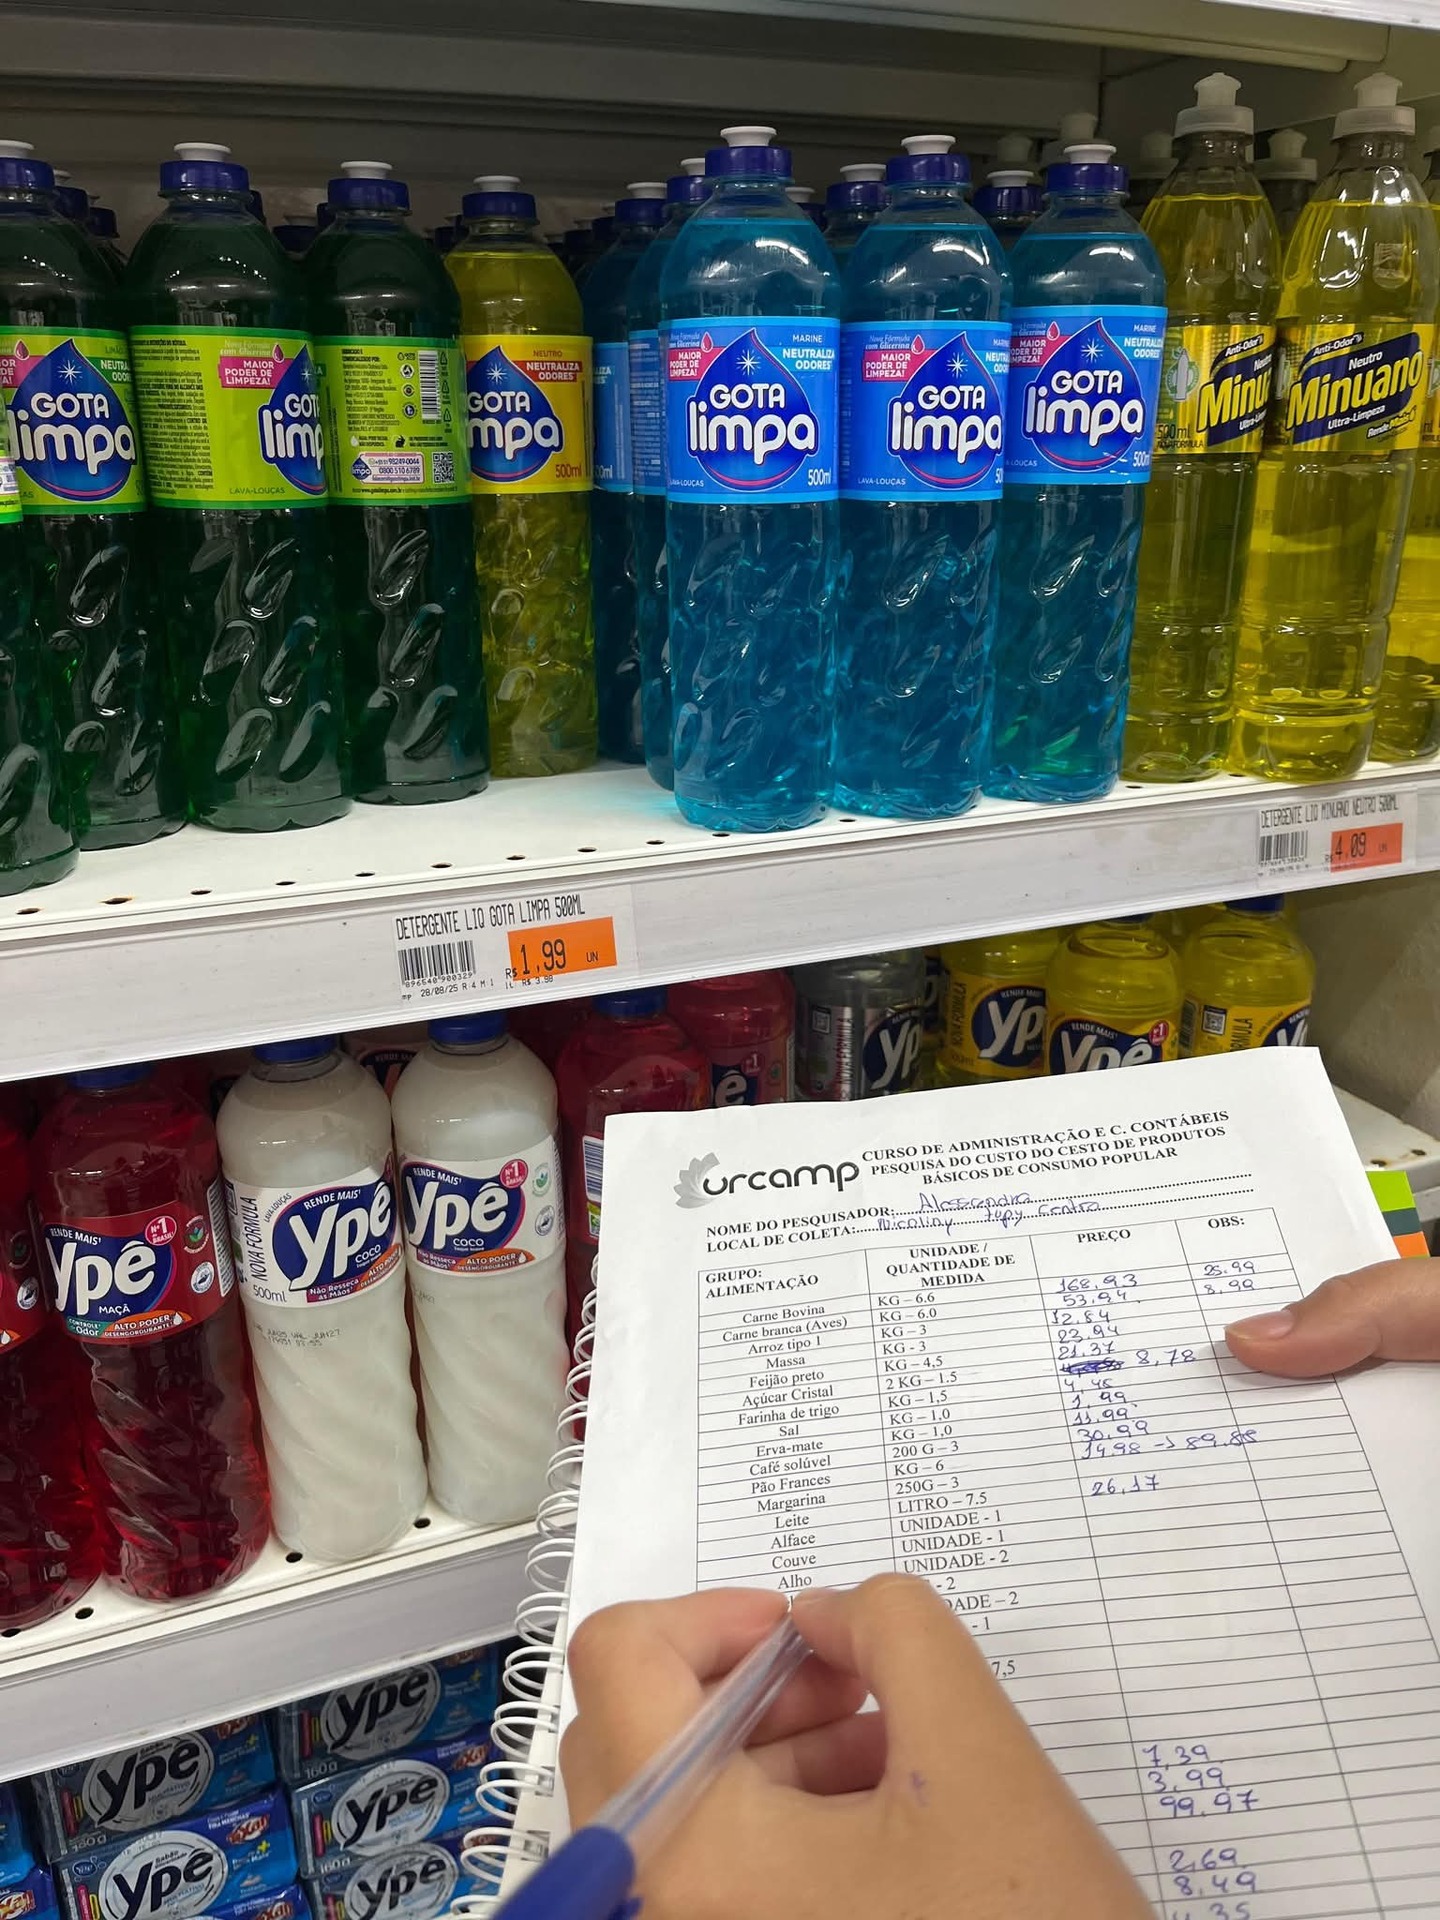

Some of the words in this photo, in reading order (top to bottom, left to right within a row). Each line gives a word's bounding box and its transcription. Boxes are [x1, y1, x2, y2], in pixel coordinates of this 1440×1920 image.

[1134, 325, 1156, 333] MARINE
[793, 335, 822, 343] MARINE
[783, 348, 835, 358] NEUTRALIZA
[1349, 351, 1383, 371] Neutro
[225, 368, 257, 376] PODER
[260, 369, 272, 377] DE
[244, 360, 274, 369] MAIOR
[526, 362, 580, 371] NEUTRALIZA
[866, 370, 904, 378] LIMPEZA!
[226, 377, 270, 385] LIMPEZA!
[1051, 370, 1122, 394] GOTA
[1286, 350, 1423, 431] Minuano
[31, 392, 109, 418] GOTA
[467, 392, 530, 413] GOTA
[710, 384, 785, 409] GOTA
[918, 386, 985, 410] GOTA
[1025, 386, 1143, 447] limpa
[1328, 405, 1385, 430] Ultra-Limpeza
[689, 401, 815, 465] limpa
[892, 401, 1001, 464] limpa
[1367, 424, 1389, 438] Rende
[7, 409, 136, 475] limpa
[556, 464, 582, 478] 500ml
[808, 468, 831, 485] 500ml
[858, 477, 905, 487] LAVA-LOUÇAS
[1261, 806, 1302, 828] DETERGENTE
[1322, 801, 1349, 819] MINUANO
[1352, 796, 1376, 815] NEUTRO
[396, 910, 460, 940] DETERGENTE
[465, 908, 484, 931] LIQ
[490, 905, 514, 927] GOTA
[520, 899, 549, 923] LIMPA
[555, 894, 585, 918] 500ML
[505, 968, 517, 979] R$
[521, 939, 566, 974] 1,99
[586, 952, 598, 962] UN
[980, 998, 1047, 1058] Yp
[871, 1020, 920, 1090] Yp
[862, 1146, 917, 1162] CURSO
[922, 1144, 944, 1155] DE
[949, 1128, 1090, 1154] ADMINISTRAÇÃO
[1095, 1127, 1106, 1138] E
[1110, 1125, 1126, 1135] C.
[1131, 1110, 1229, 1133] CONTÁBEIS
[871, 1159, 945, 1175] PESQUISA
[950, 1156, 971, 1167] DO
[975, 1150, 1027, 1164] CUSTO
[1032, 1148, 1054, 1159] DO
[1058, 1141, 1109, 1157] CESTO
[1113, 1138, 1136, 1150] DE
[1140, 1126, 1226, 1146] PRODUTOS
[923, 1168, 989, 1185] BÁSICOS
[993, 1166, 1014, 1177] DE
[1018, 1156, 1098, 1174] CONSUMO
[1102, 1147, 1178, 1166] POPULAR
[703, 1161, 860, 1196] urcamp
[303, 1194, 335, 1210] RENDE
[407, 1176, 508, 1249] Ypê
[1208, 1215, 1245, 1229] OBS:
[707, 1222, 752, 1238] NOME
[756, 1219, 778, 1232] DO
[782, 1207, 895, 1229] PESQUISADOR:
[50, 1228, 73, 1238] RENDE
[289, 1182, 391, 1291] Ypê
[453, 1238, 484, 1247] COCO
[707, 1238, 760, 1253] LOCAL
[764, 1234, 784, 1247] DE
[788, 1225, 856, 1243] COLETA:
[1078, 1229, 1131, 1244] PREÇO
[355, 1244, 381, 1264] COCO
[490, 1254, 516, 1262] PODER
[910, 1244, 979, 1259] UNIDADE
[247, 1248, 268, 1281] NOVA
[886, 1257, 990, 1276] QUANTIDADE
[995, 1254, 1015, 1266] DE
[45, 1237, 156, 1315] Ypê
[706, 1269, 762, 1284] GRUPO:
[921, 1273, 985, 1287] MEDIDA
[253, 1285, 287, 1303] 500ml
[706, 1275, 818, 1298] ALIMENTAÇÃO
[99, 1304, 130, 1315] MAÇÃ
[878, 1295, 900, 1306] KG
[114, 1319, 136, 1330] ALTO
[139, 1315, 170, 1327] PODER
[743, 1311, 778, 1323] Carne
[782, 1306, 825, 1318] Bovina
[880, 1311, 902, 1322] KG
[723, 1328, 758, 1342] Carne
[762, 1324, 802, 1337] branca
[806, 1316, 848, 1333] (Aves)
[749, 1342, 783, 1354] Arroz
[788, 1338, 811, 1352] tipo
[816, 1336, 821, 1345] 1
[766, 1355, 806, 1369] Massa
[885, 1359, 907, 1372] KG
[923, 1355, 943, 1368] 4,5
[750, 1374, 788, 1389] Feijão
[792, 1370, 824, 1386] preto
[742, 1392, 787, 1408] Açúcar
[791, 1385, 833, 1400] Cristal
[888, 1395, 911, 1408] KG
[739, 1410, 786, 1425] Farinha
[791, 1407, 806, 1420] de
[810, 1404, 839, 1418] trigo
[890, 1412, 913, 1425] KG
[780, 1425, 799, 1436] Sal
[757, 1439, 823, 1457] Erva-mate
[750, 1461, 780, 1476] Café
[784, 1455, 831, 1471] solúvel
[752, 1482, 775, 1494] Pão
[780, 1475, 831, 1490] Frances
[758, 1493, 826, 1512] Margarina
[898, 1496, 948, 1513] LITRO
[776, 1514, 810, 1528] Leite
[900, 1511, 979, 1533] UNIDADE
[996, 1509, 1001, 1522] 1
[771, 1534, 816, 1549] Alface
[772, 1554, 817, 1569] Couve
[904, 1552, 986, 1574] UNIDADE
[1000, 1550, 1009, 1563] 2
[778, 1574, 812, 1589] Alho
[97, 1740, 200, 1825] Ypê
[344, 1775, 439, 1849] Ypê
[113, 1849, 214, 1920] Ypê
[357, 1856, 447, 1920] Ypê
